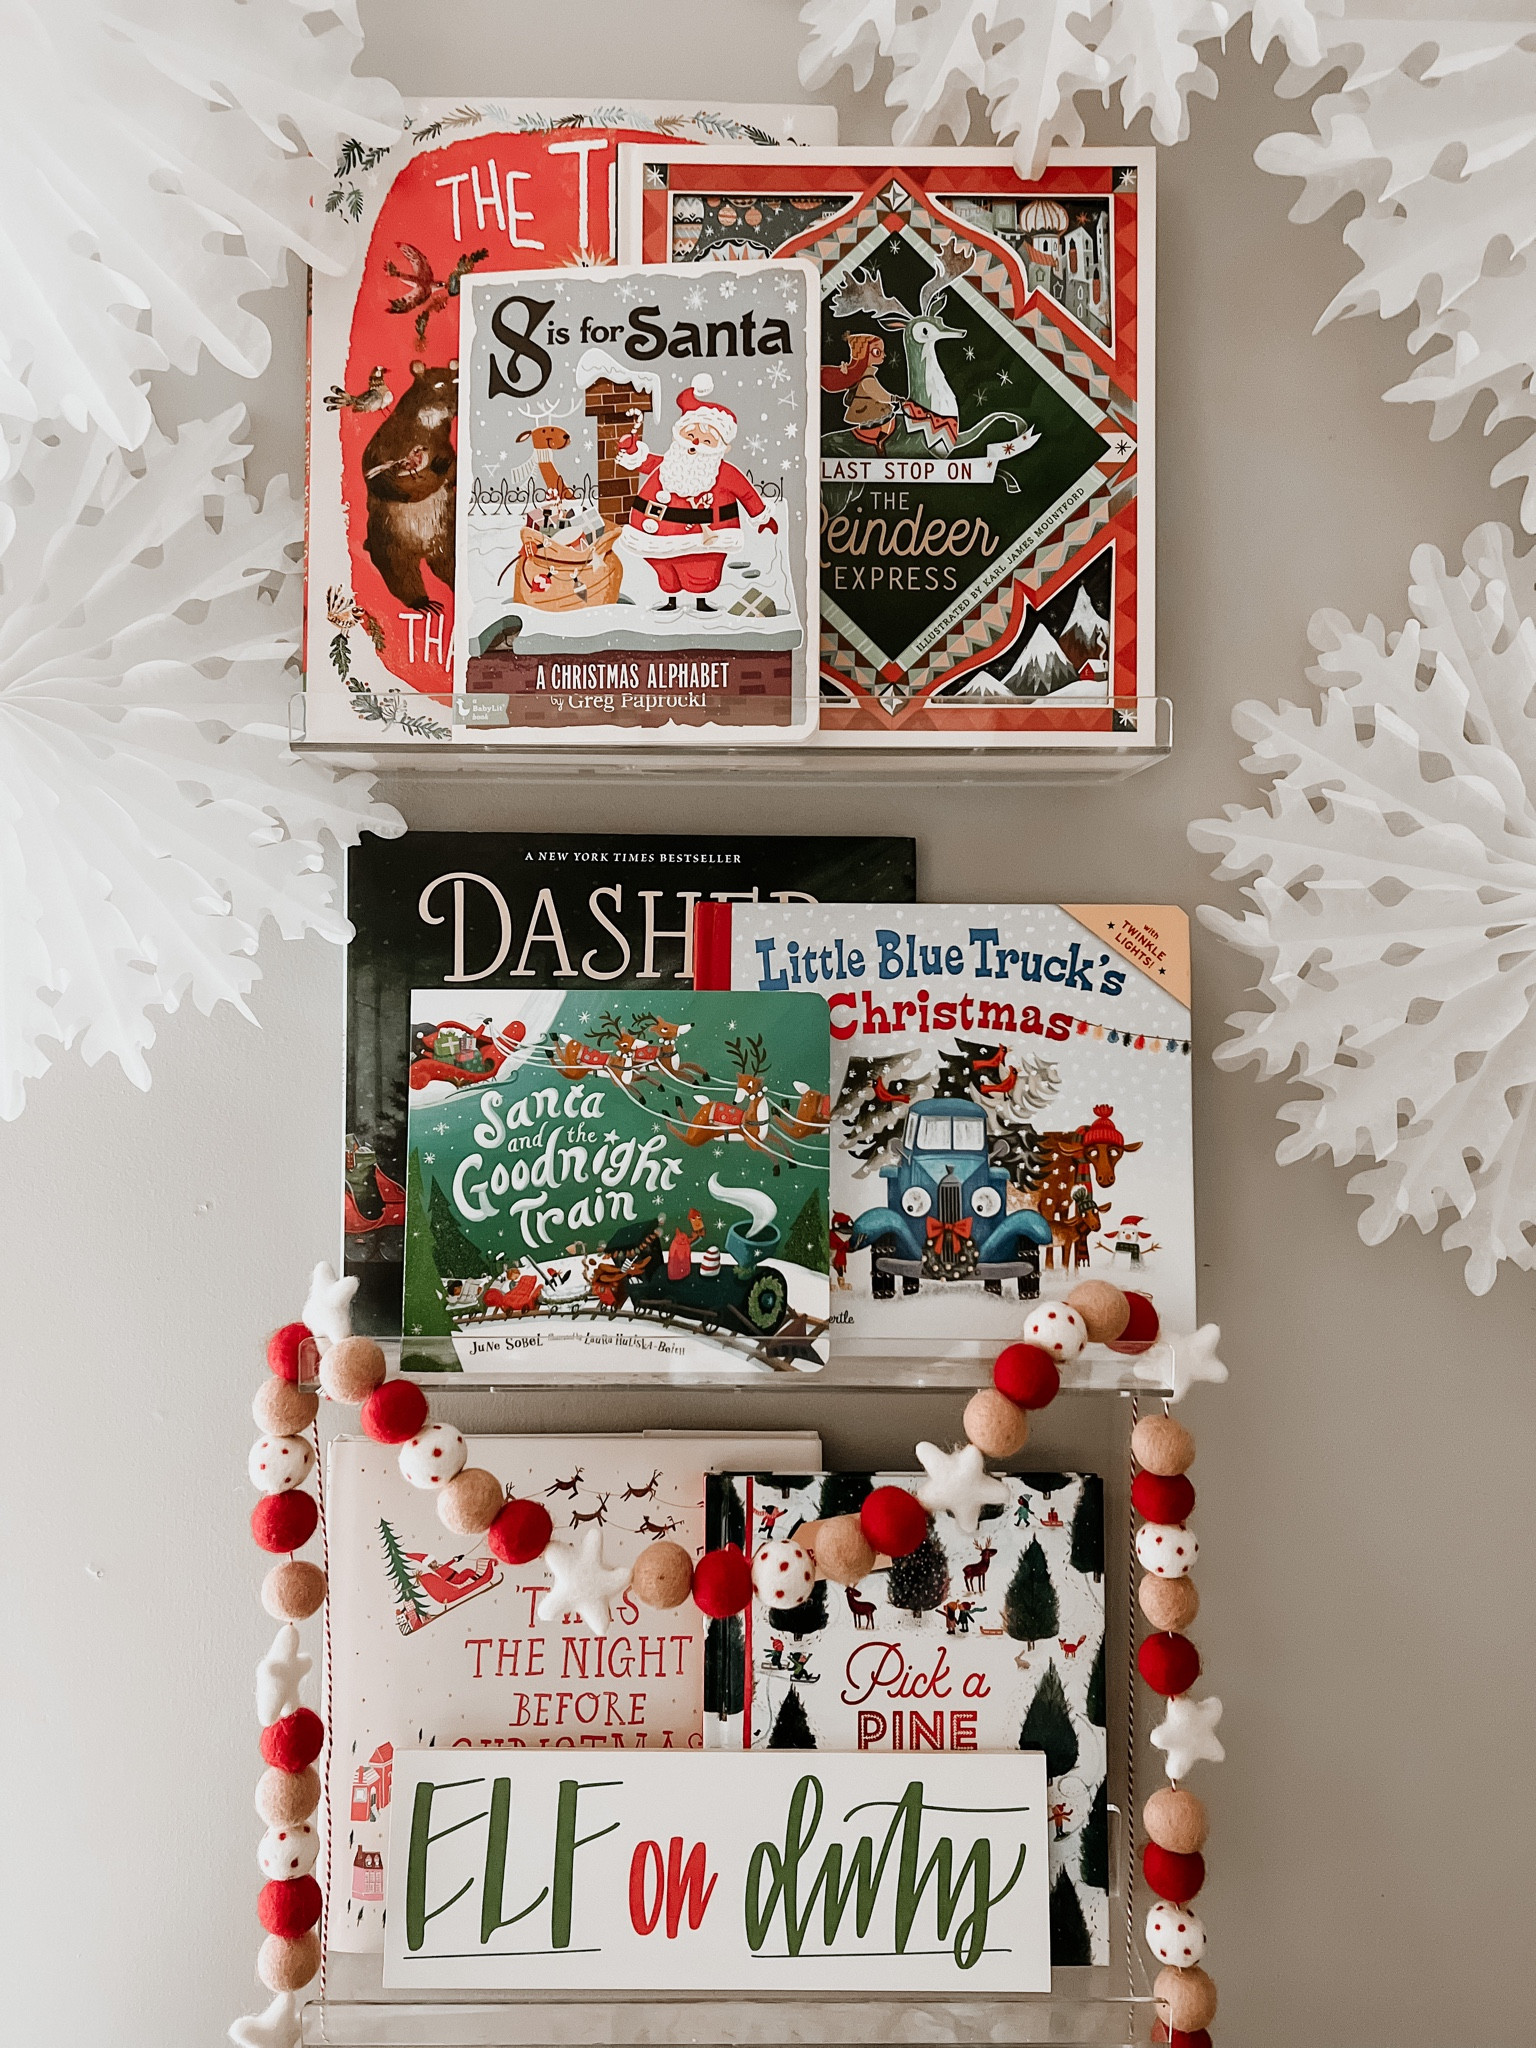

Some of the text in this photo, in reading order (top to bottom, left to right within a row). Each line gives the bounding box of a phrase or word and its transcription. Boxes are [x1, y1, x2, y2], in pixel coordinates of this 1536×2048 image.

[435, 139, 617, 258] THE T
[488, 295, 793, 399] S is for Santa
[821, 461, 972, 480] LAST STOP ON
[870, 492, 910, 510] THE
[834, 566, 957, 591] EXPRESS
[915, 487, 1085, 652] ILLUSTRATED BY KARL JAMES MOUNTFORD
[536, 662, 730, 690] A CHRISTMAS ALPHABET
[550, 692, 707, 712] by Greg Paprocki
[525, 852, 742, 864] A NEW YORK TIMES BESTSELLER
[418, 872, 818, 982] DASH
[1122, 920, 1167, 962] TWINKLE
[1143, 924, 1159, 940] with
[755, 928, 1126, 996] Little Blue Truck's
[1114, 932, 1155, 969] LIGHTS!
[827, 989, 1074, 1041] Christmas
[473, 1084, 606, 1149] Santa
[507, 1121, 598, 1153] and the
[452, 1125, 684, 1222] Goodnight
[509, 1186, 638, 1249] Train
[828, 1309, 855, 1324] ertle
[515, 1585, 640, 1628] 'TS
[464, 1636, 693, 1679] THE NIGHT
[840, 1641, 991, 1706] Pick a
[509, 1691, 646, 1727] BEFORE
[857, 1710, 978, 1750] PINE
[405, 1774, 1030, 1970] ELF on duty
